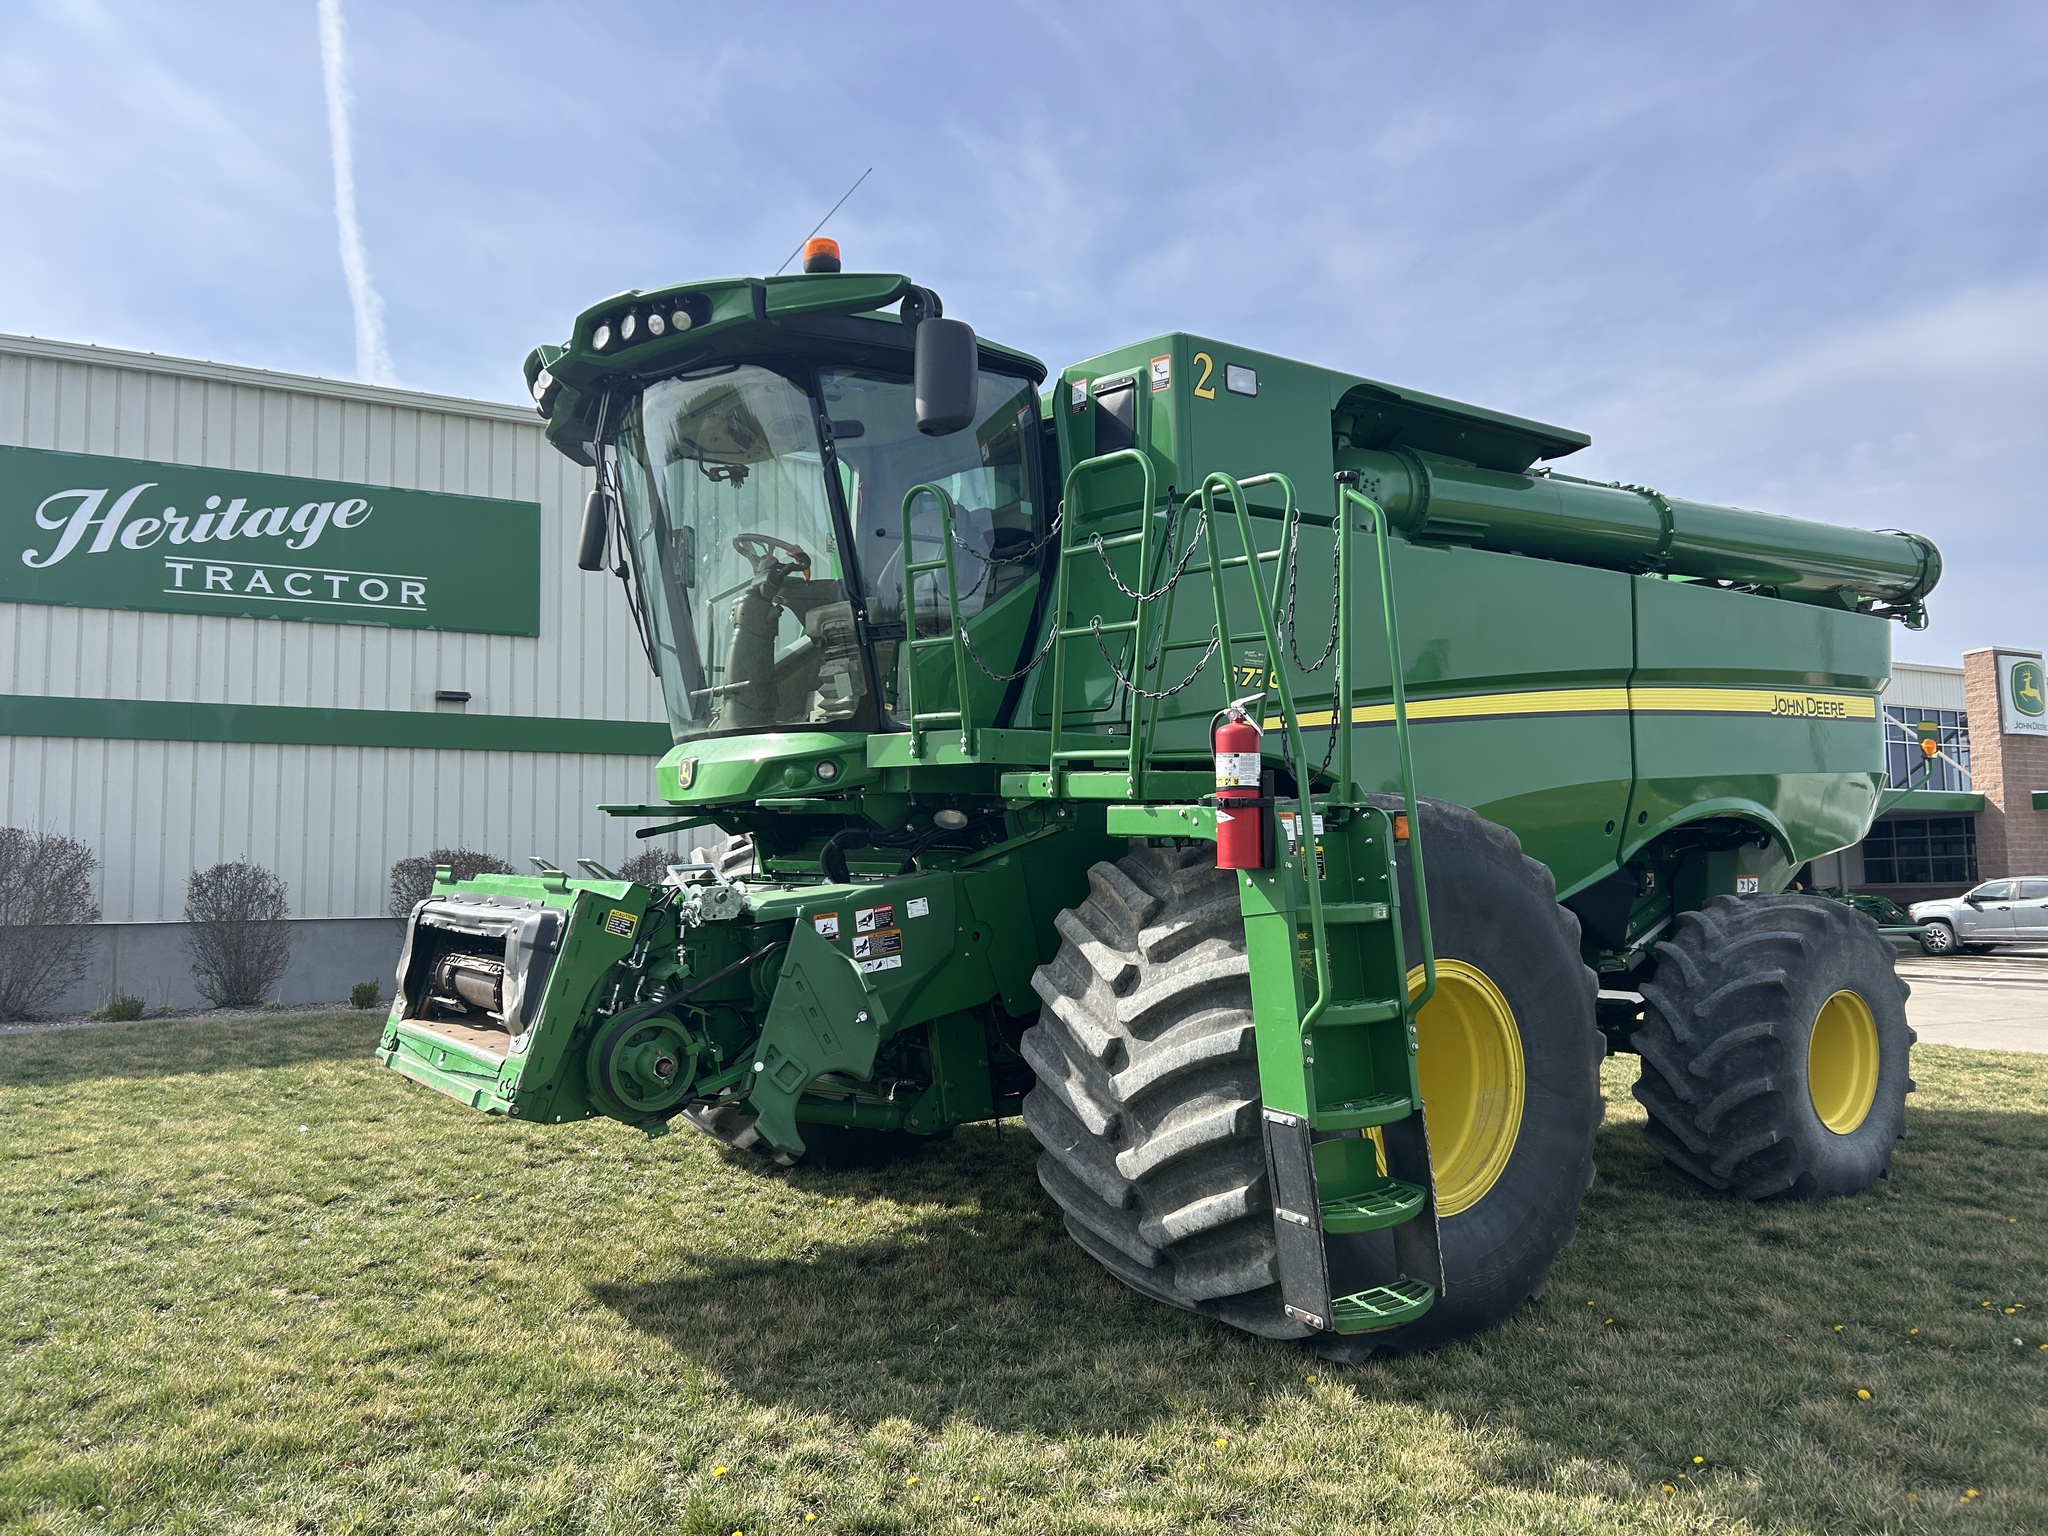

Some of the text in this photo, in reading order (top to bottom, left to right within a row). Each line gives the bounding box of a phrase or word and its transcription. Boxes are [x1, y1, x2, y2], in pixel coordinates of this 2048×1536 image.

[1193, 351, 1215, 400] 2
[21, 482, 373, 568] Heritage
[165, 560, 426, 605] TRACTOR
[1771, 695, 1846, 716] JOHN DEERE
[615, 911, 636, 921] CAUTION
